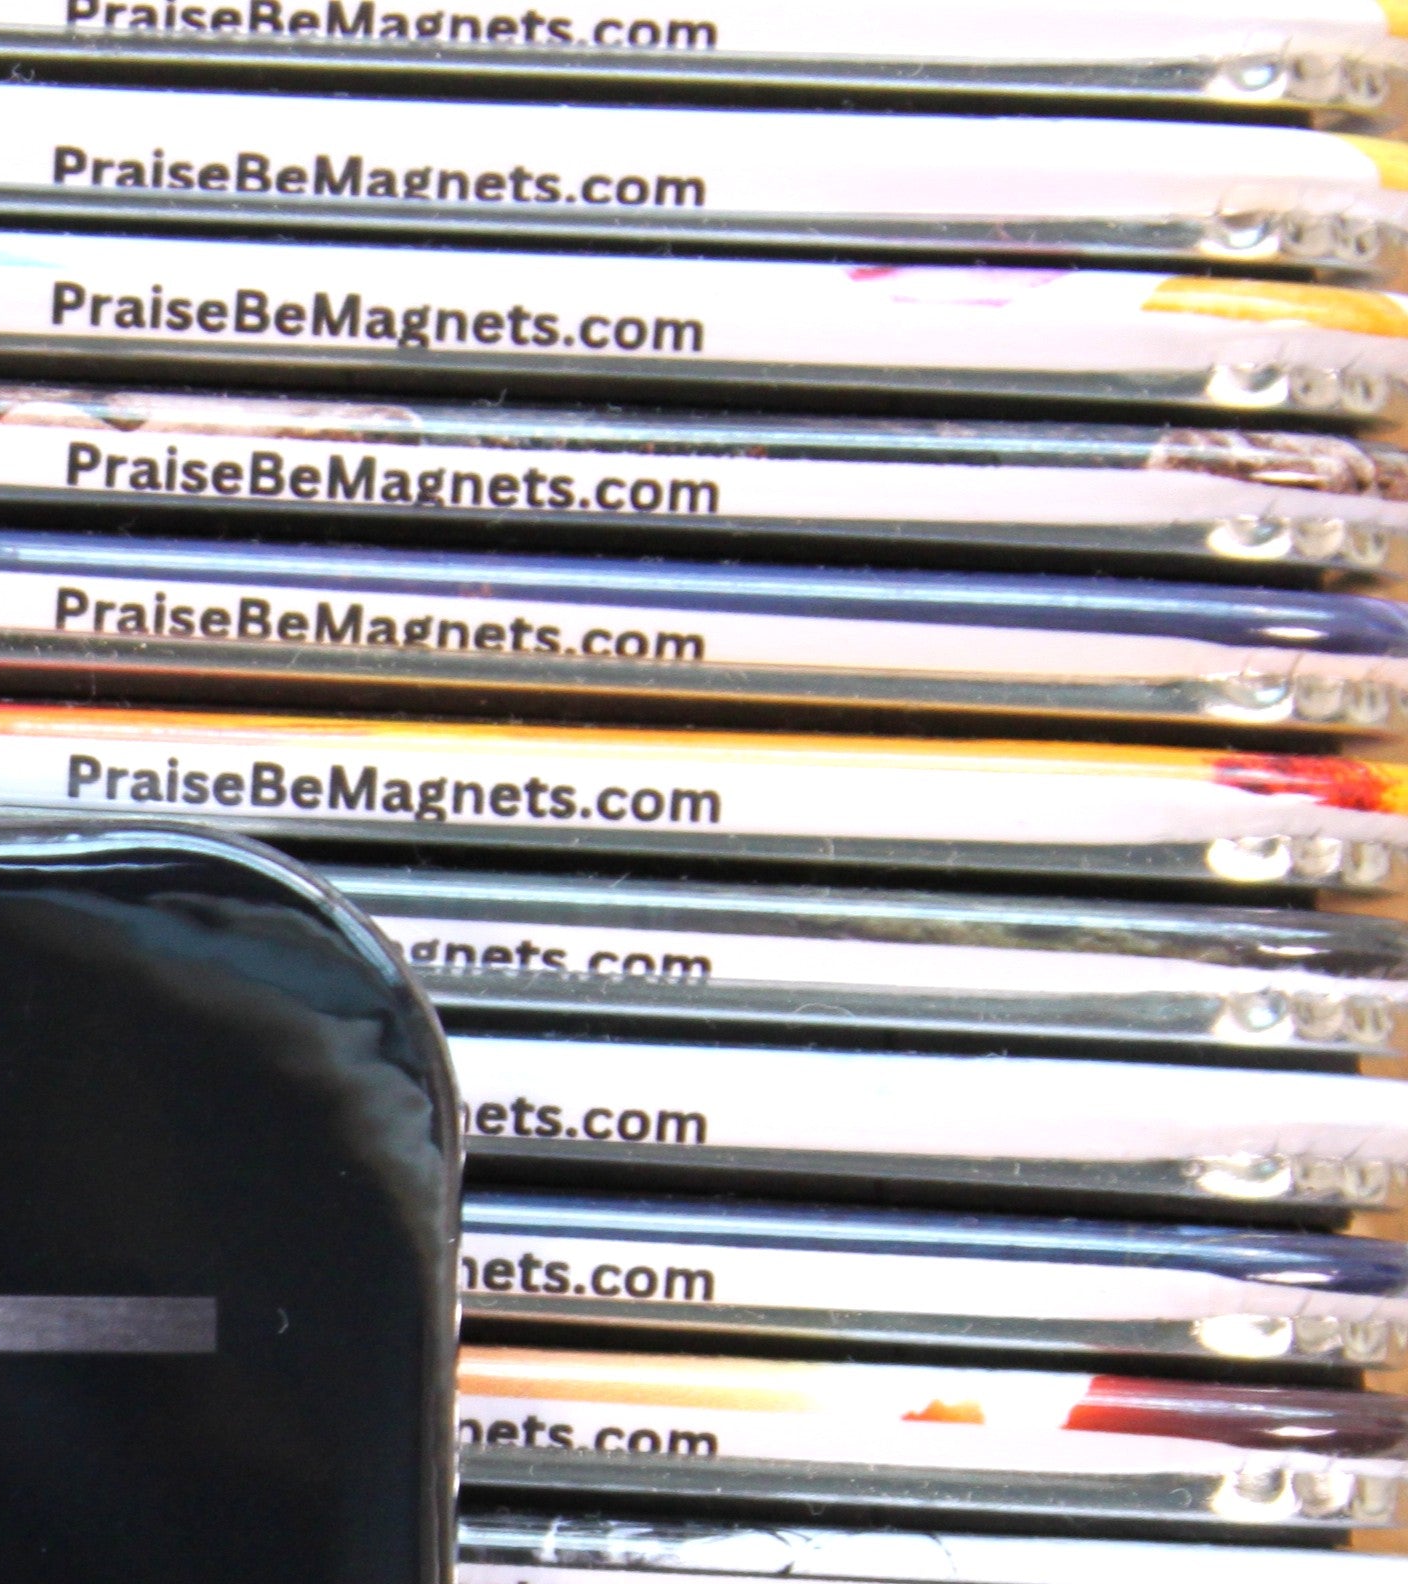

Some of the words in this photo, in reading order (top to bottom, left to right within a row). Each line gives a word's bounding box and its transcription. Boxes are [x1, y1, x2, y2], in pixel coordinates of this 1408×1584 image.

[53, 146, 706, 207] PraiseBeMagnets.com
[51, 282, 704, 352] PraiseBeMagnets.com
[67, 442, 719, 514] PraiseBeMagnets.com
[68, 755, 720, 824] PraiseBeMagnets.com
